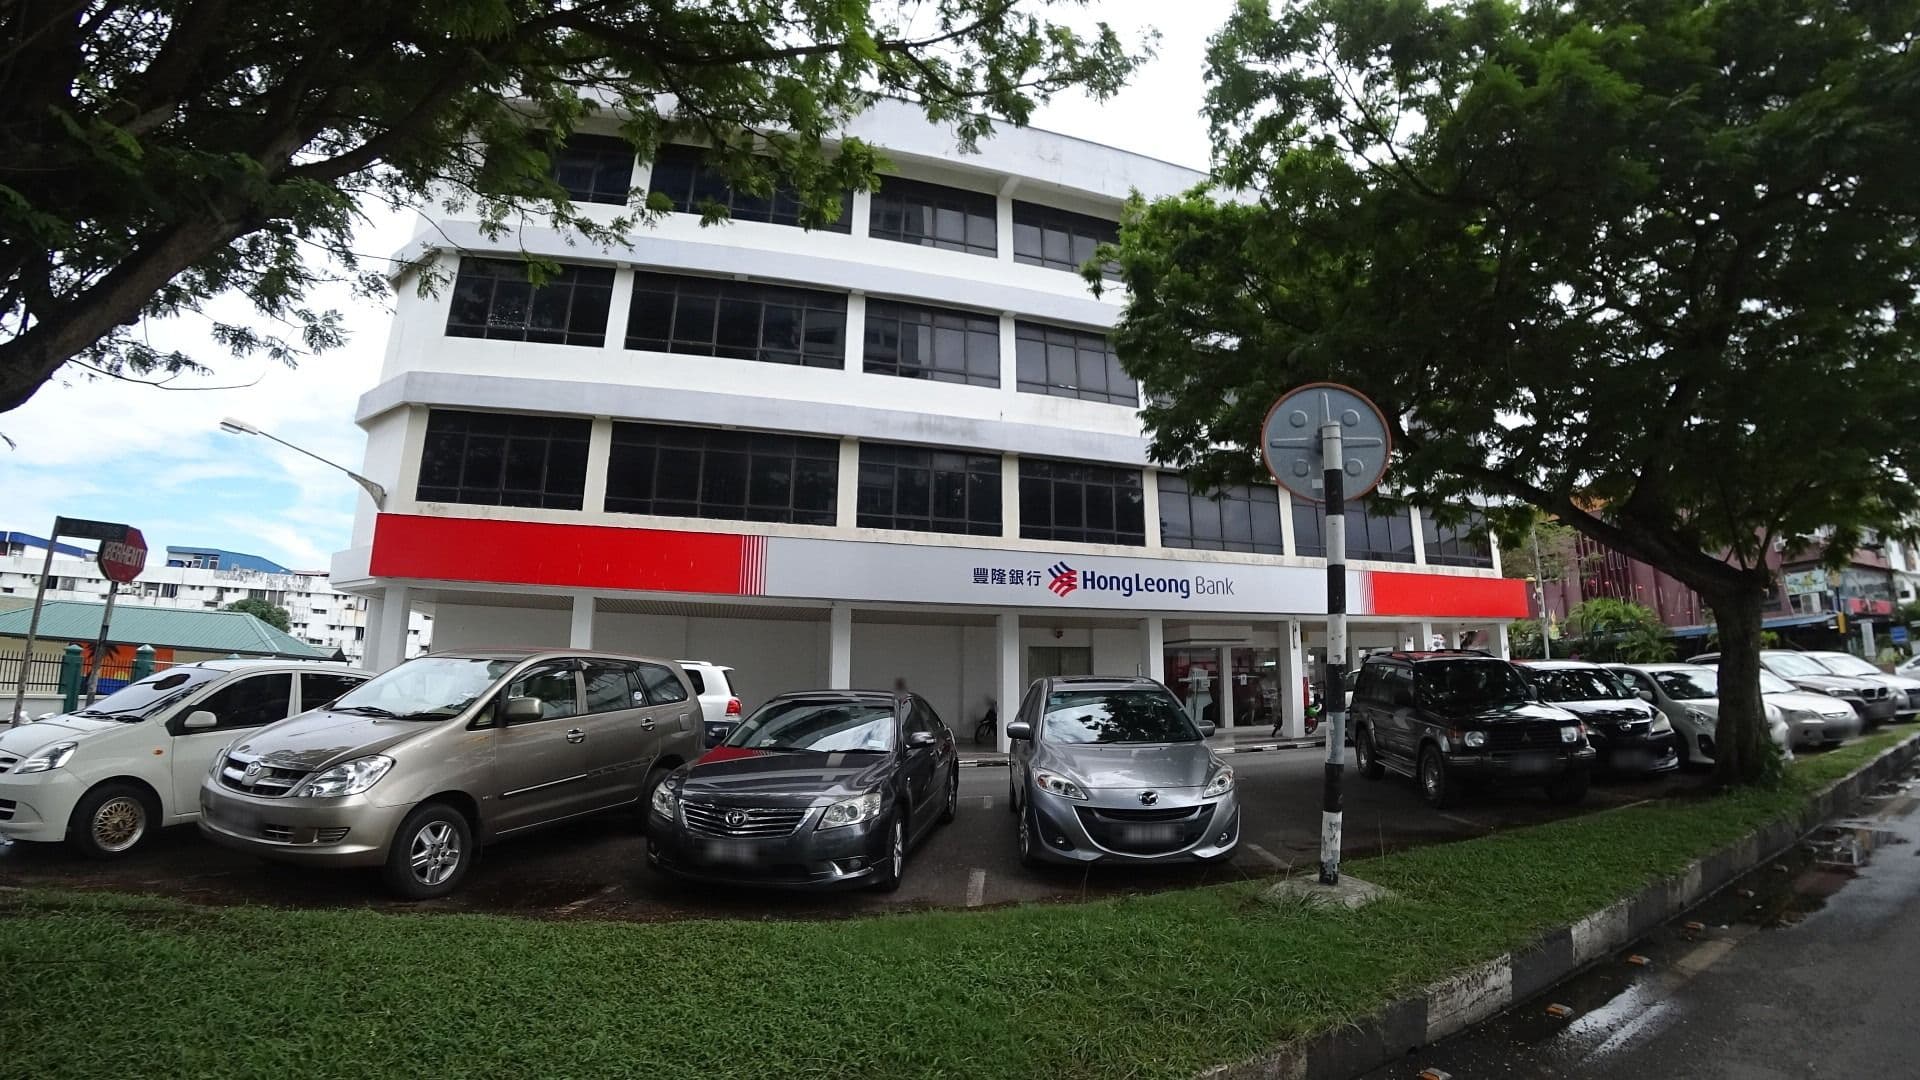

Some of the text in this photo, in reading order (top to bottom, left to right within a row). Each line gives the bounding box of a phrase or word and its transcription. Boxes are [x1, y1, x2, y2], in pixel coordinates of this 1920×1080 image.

[104, 541, 145, 568] BERHENTI
[972, 567, 1042, 587] 豐隆銀行
[1195, 575, 1235, 596] Bank
